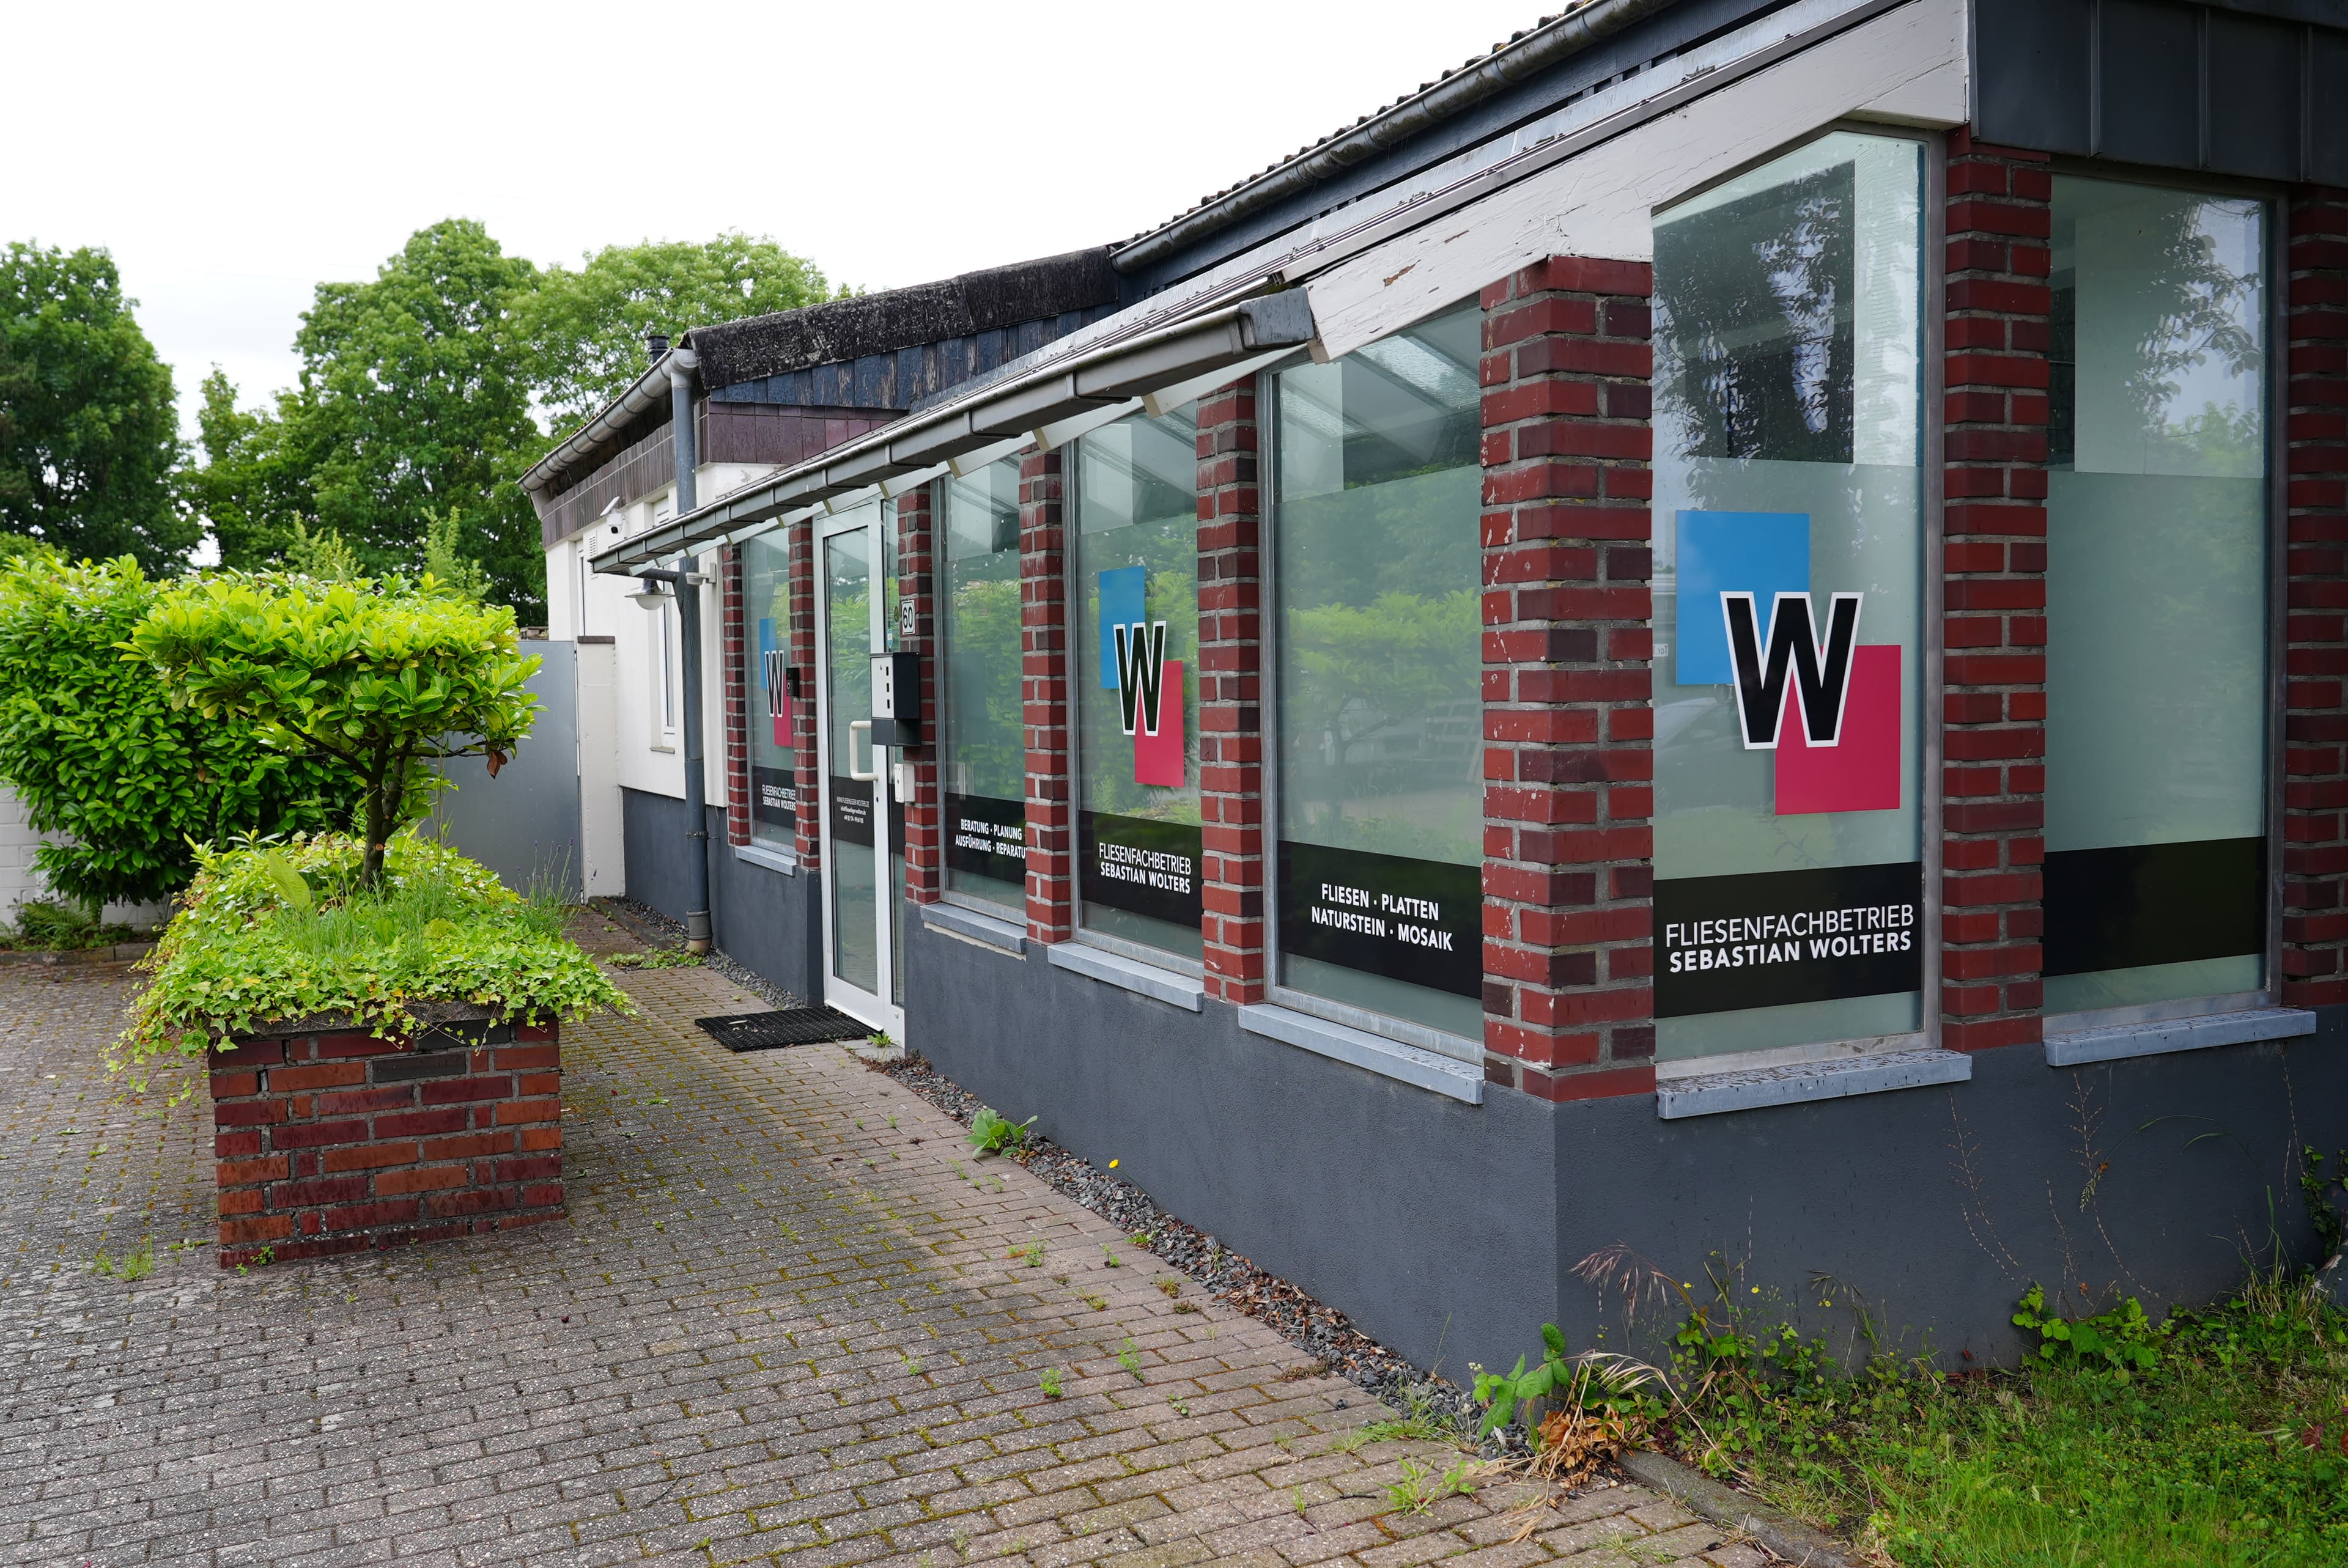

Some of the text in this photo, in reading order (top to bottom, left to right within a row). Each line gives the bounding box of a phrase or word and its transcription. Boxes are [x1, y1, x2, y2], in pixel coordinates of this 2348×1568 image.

[903, 606, 913, 628] 60
[764, 650, 784, 718] W
[1113, 620, 1167, 737] W
[1719, 591, 1864, 749] W
[955, 834, 1027, 859] AUSFÜHRUNG REPARATU
[961, 819, 1022, 841] BERATUNG PLANUNG
[1099, 842, 1191, 875] FLIESENFACHBETRIEB
[1101, 861, 1191, 894] SEBASTIAN WOLTERS
[1321, 883, 1439, 921] FLIESEN PLATTEN
[1312, 906, 1453, 951] NATURSTEIN MOSAIK
[1666, 904, 1914, 948] FLIESENFACHBETRIEB
[1669, 930, 1911, 973] SEBASTIAN WOLTERS
